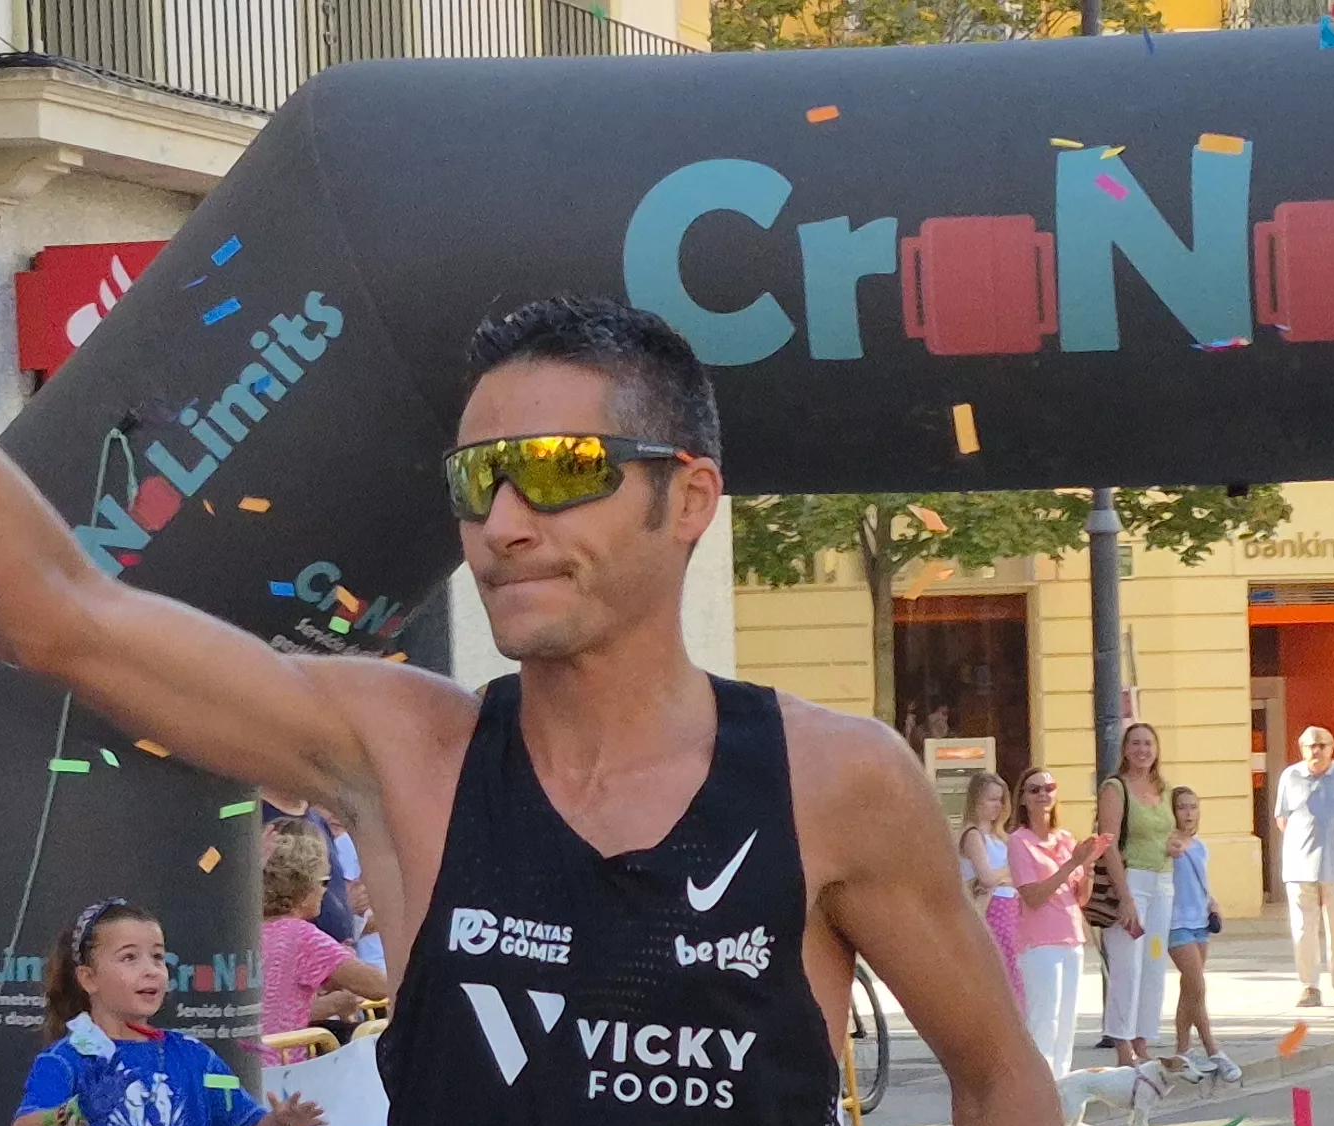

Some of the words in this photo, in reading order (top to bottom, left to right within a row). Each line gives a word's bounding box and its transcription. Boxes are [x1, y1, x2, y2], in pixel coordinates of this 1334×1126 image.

[503, 916, 573, 943] PATATAS
[674, 934, 714, 967] be
[576, 1018, 757, 1071] VICKY
[588, 1070, 734, 1109] FOODS
